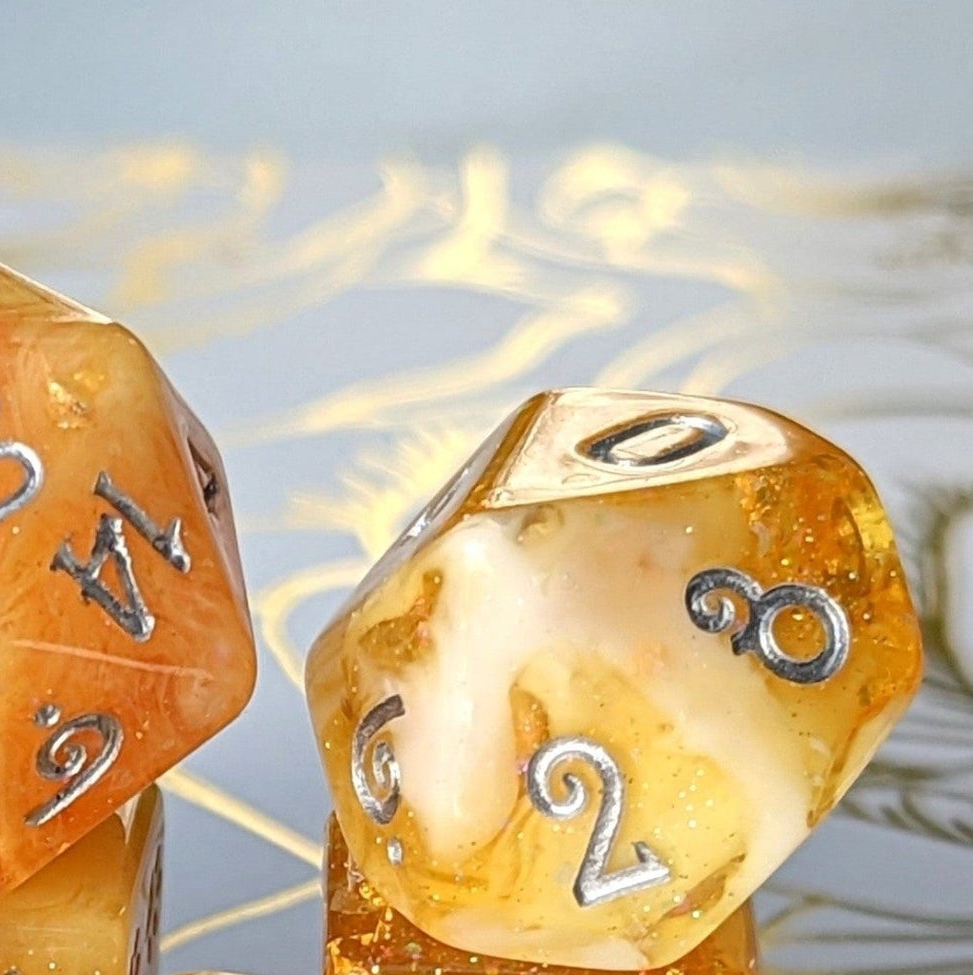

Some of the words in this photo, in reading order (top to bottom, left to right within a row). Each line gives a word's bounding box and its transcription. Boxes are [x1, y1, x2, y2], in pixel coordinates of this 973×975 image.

[575, 411, 729, 468] 0
[49, 470, 192, 643] 14
[685, 567, 851, 685] 8
[528, 735, 671, 908] 2
